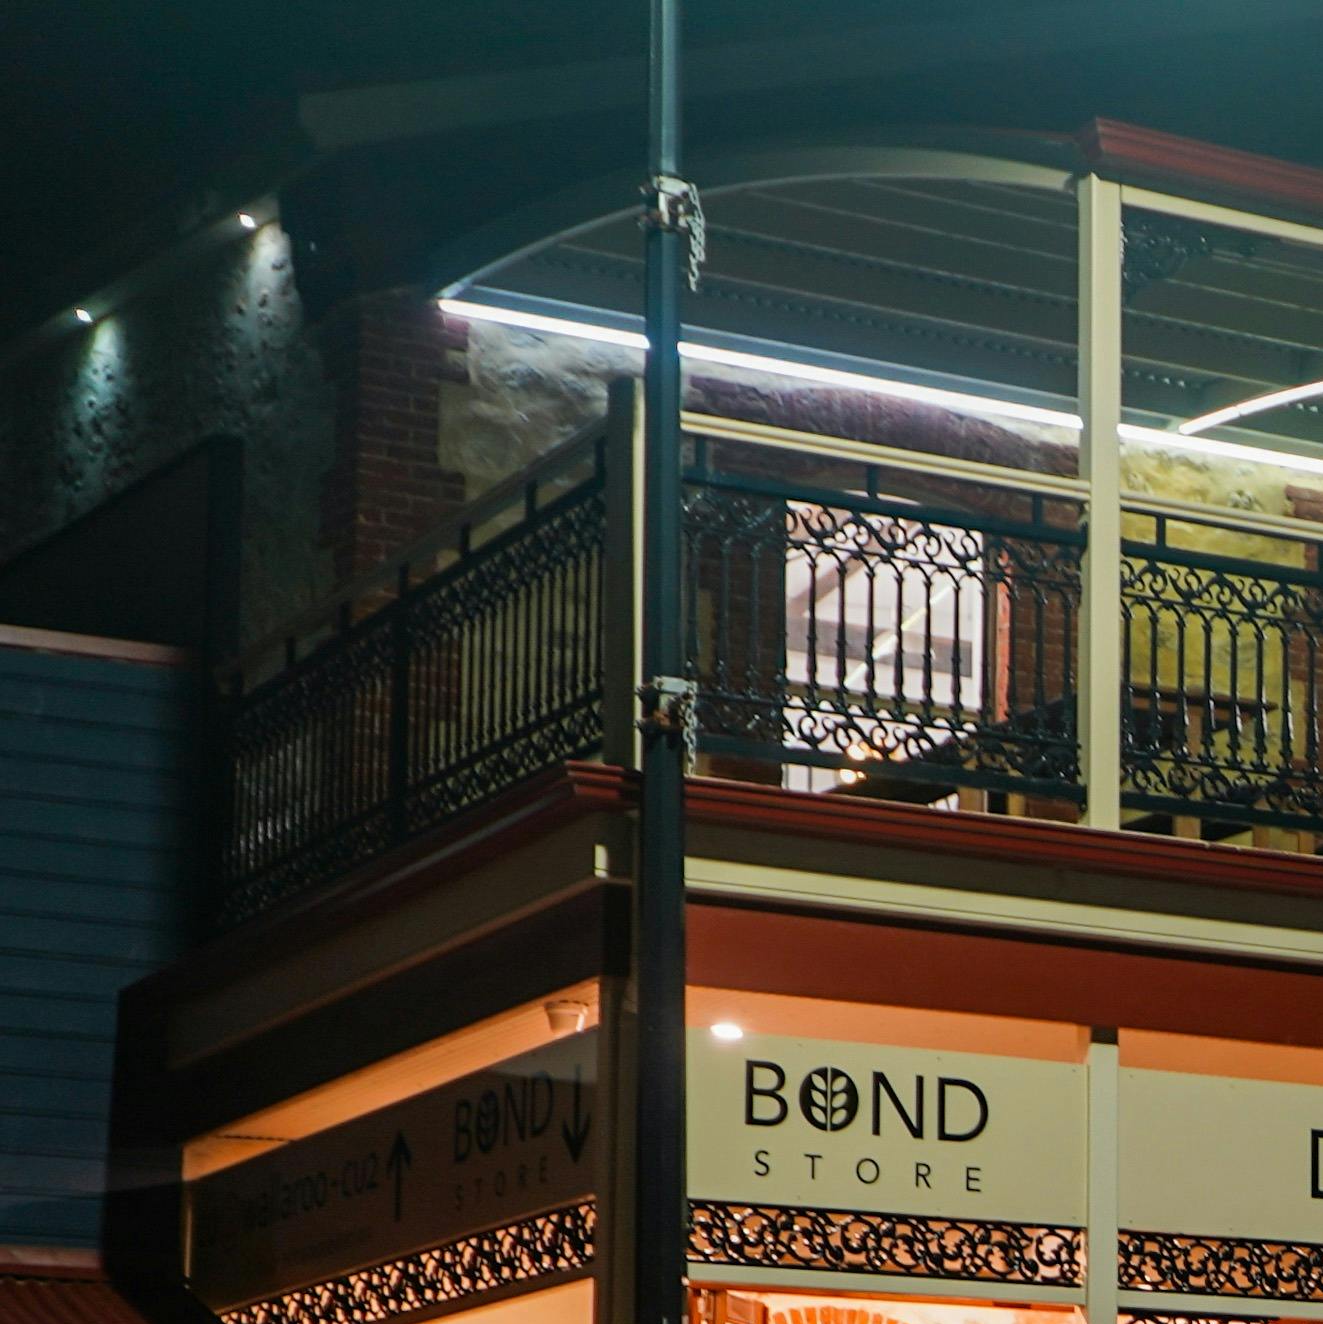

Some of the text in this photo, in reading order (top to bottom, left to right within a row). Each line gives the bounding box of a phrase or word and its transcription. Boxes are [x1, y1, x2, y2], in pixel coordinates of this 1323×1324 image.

[453, 1070, 554, 1162] BOND
[744, 1058, 990, 1142] BOND
[455, 1155, 548, 1212] STORE
[754, 1149, 982, 1193] STORE
